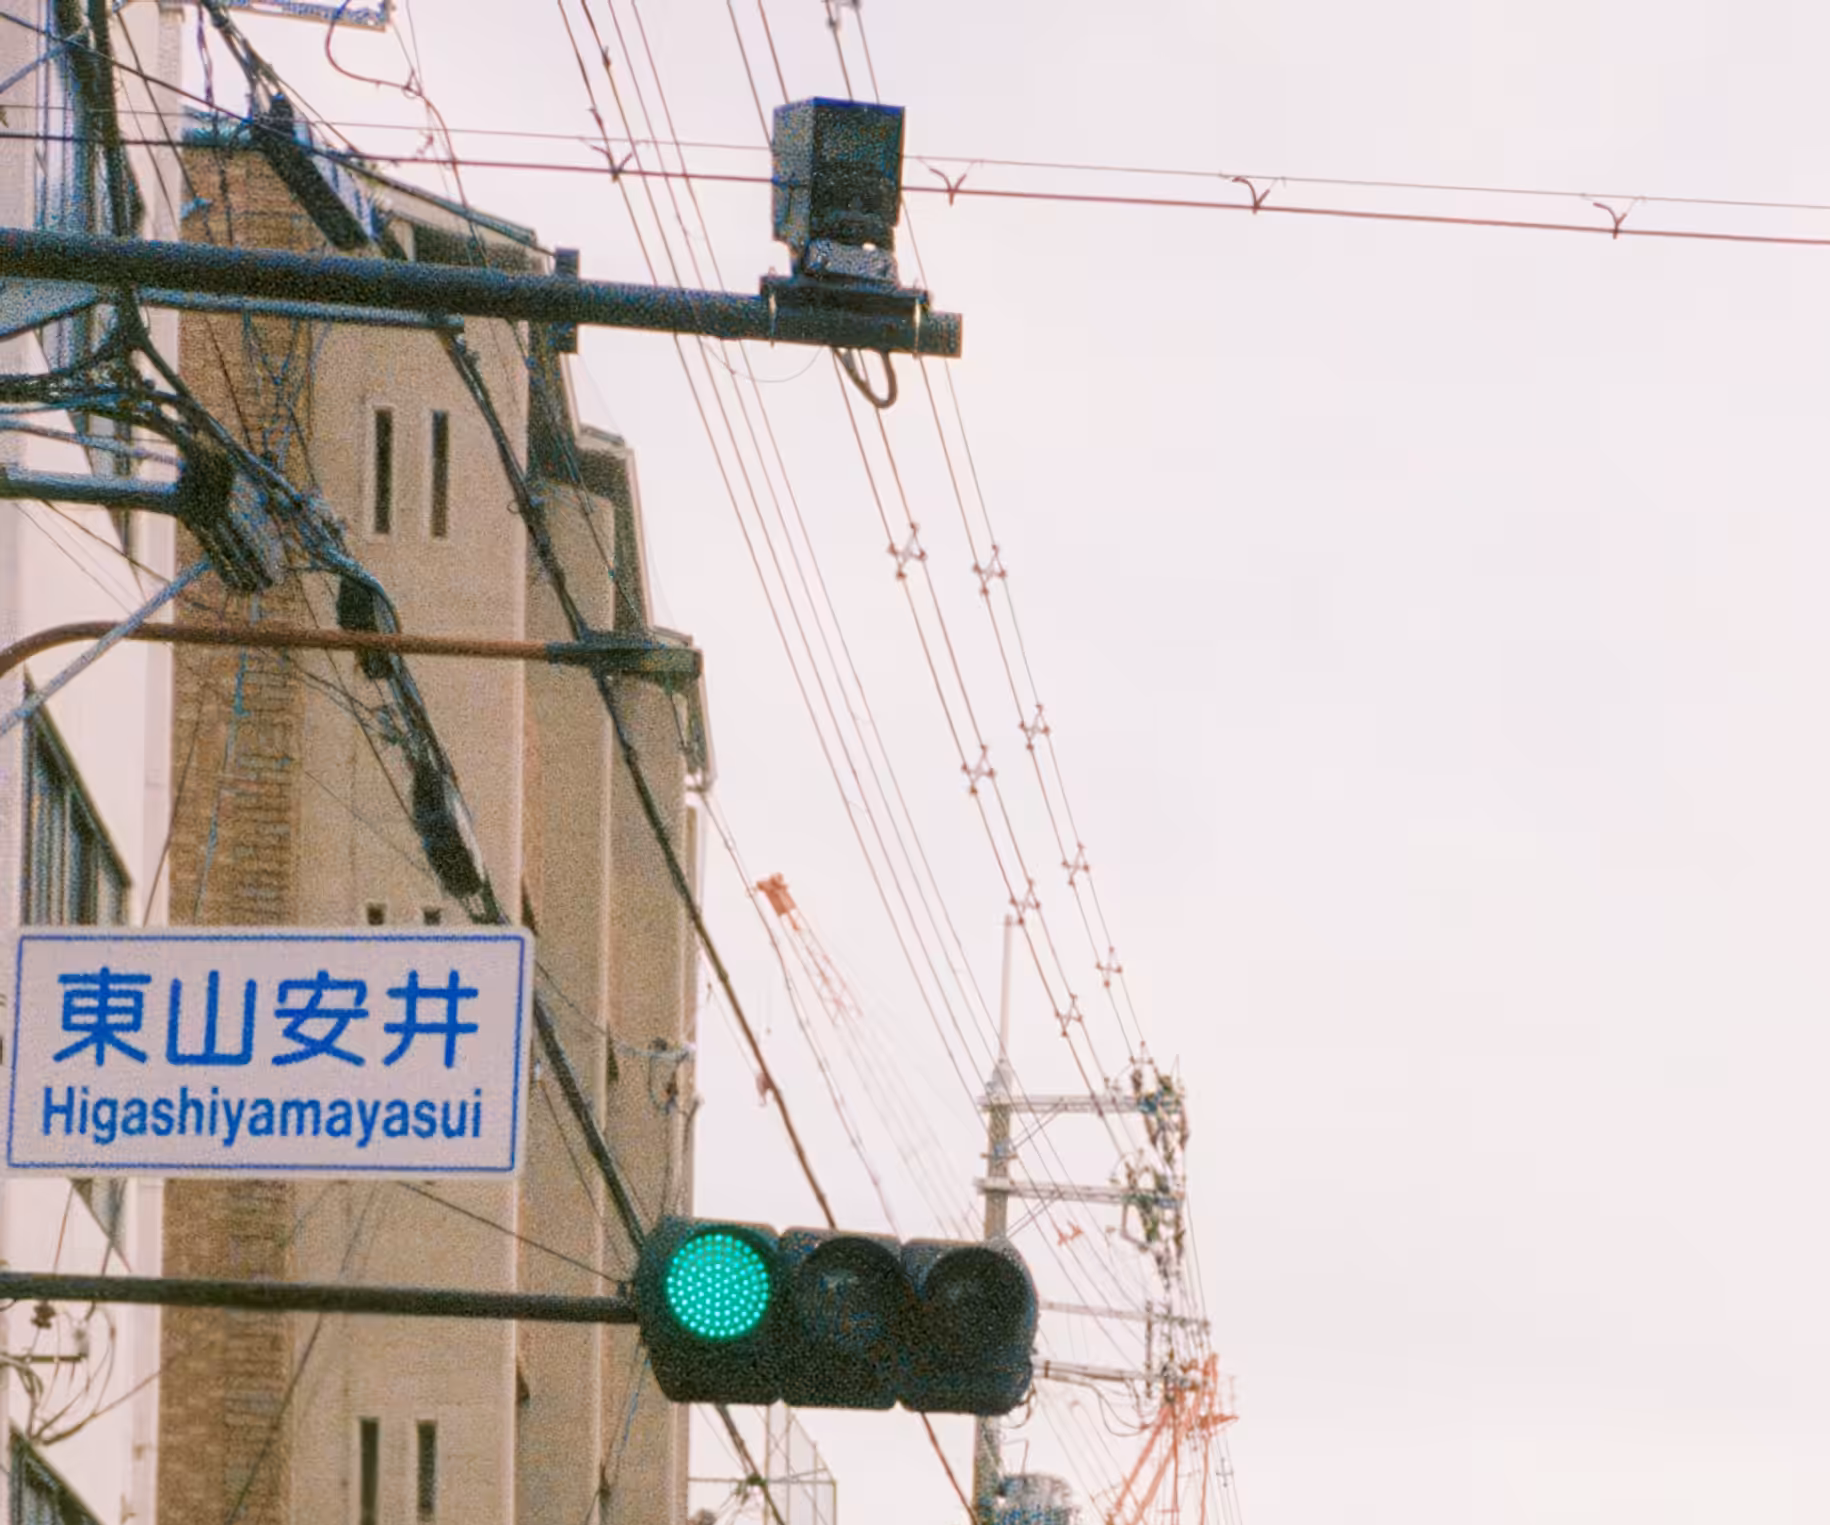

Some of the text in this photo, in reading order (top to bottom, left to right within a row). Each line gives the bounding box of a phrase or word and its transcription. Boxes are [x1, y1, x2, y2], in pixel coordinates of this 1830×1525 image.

[53, 967, 479, 1067] 東山安井
[42, 1085, 483, 1149] Higashiyamayasui
